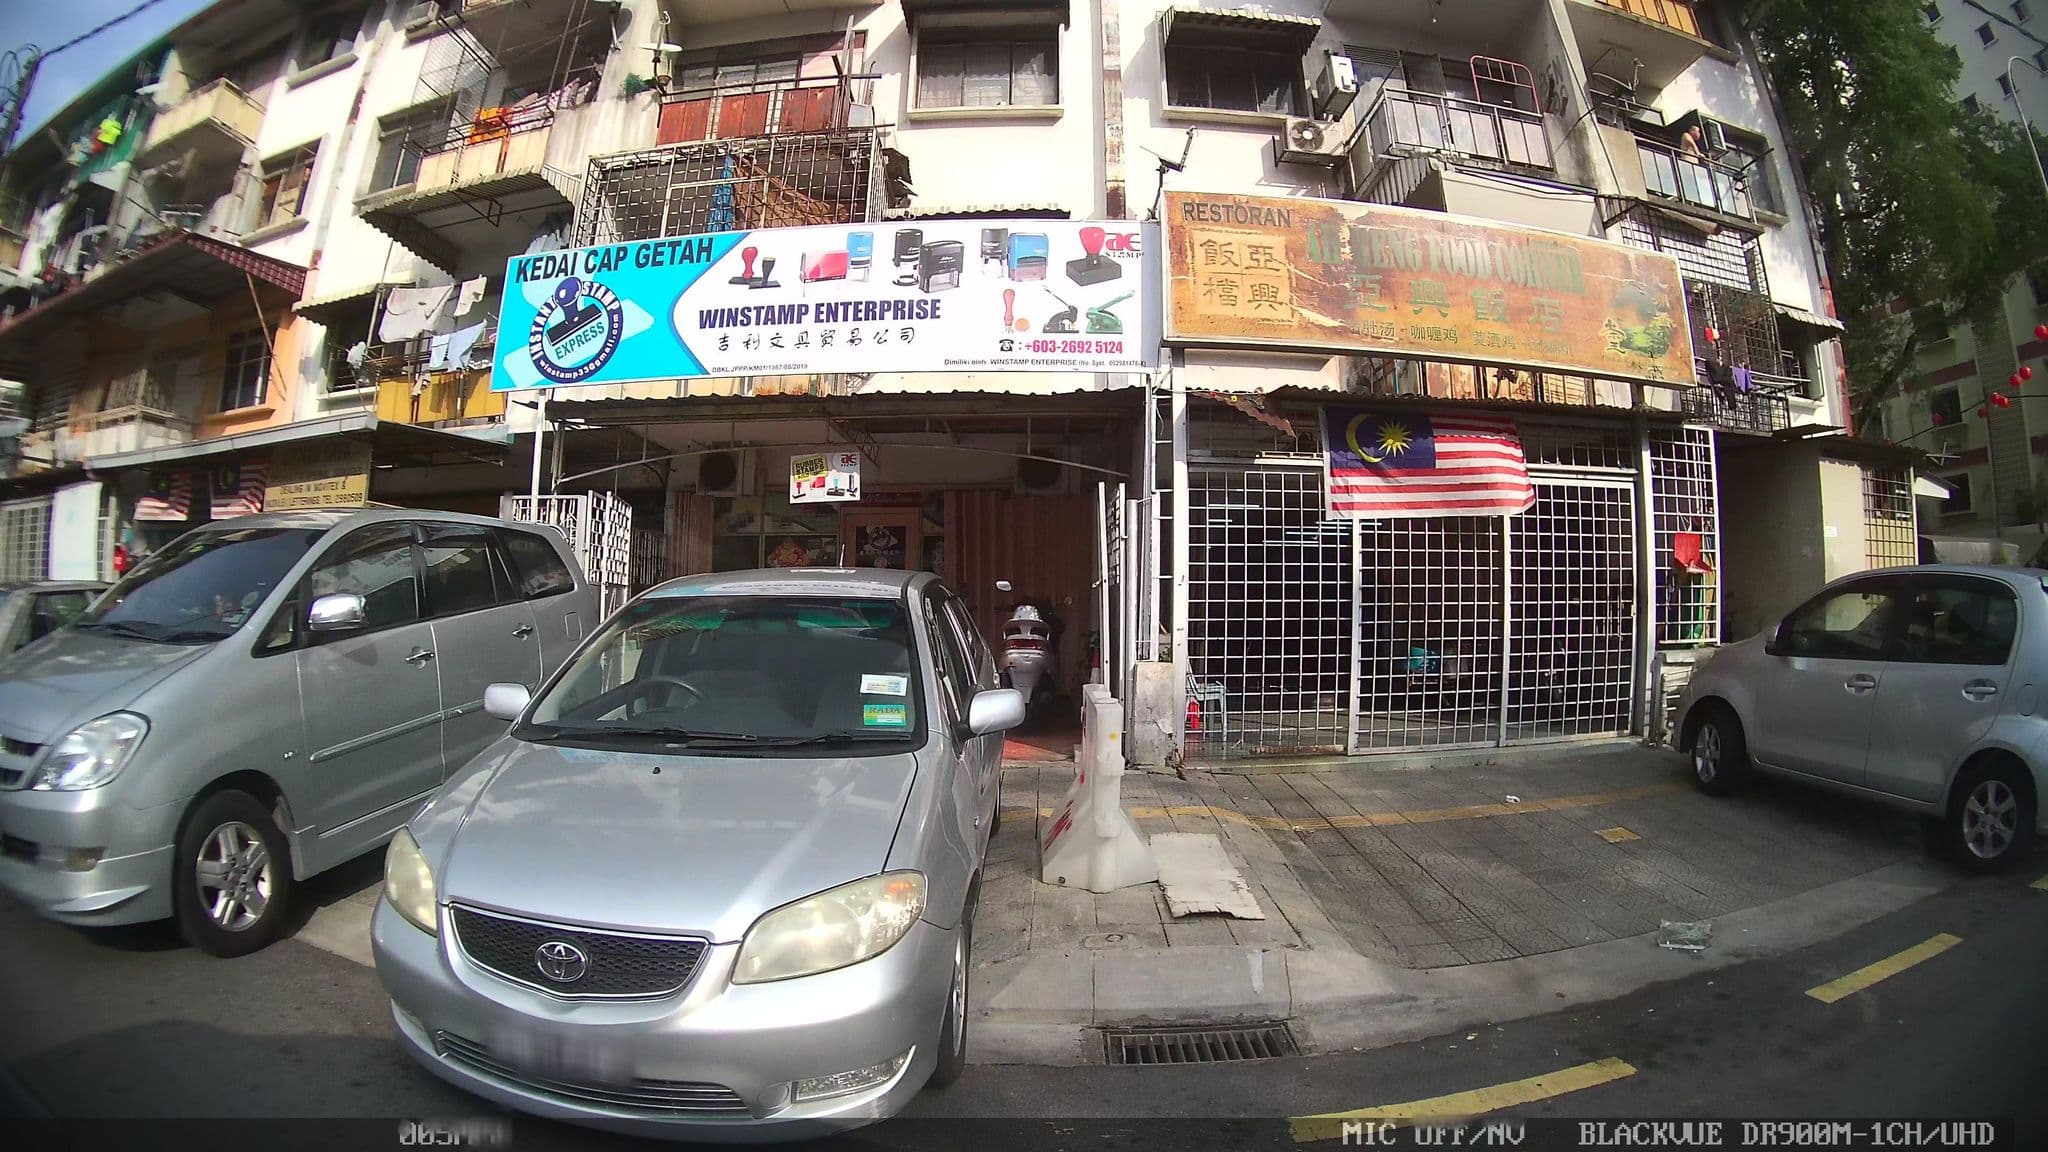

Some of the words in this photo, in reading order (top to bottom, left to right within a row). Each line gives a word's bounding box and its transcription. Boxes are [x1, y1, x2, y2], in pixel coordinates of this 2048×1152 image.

[1183, 202, 1292, 228] RESTORAN
[515, 252, 578, 283] KEDAI
[584, 246, 628, 274] CAP
[635, 237, 714, 269] GETAH
[581, 281, 620, 311] STAMP
[699, 303, 810, 330] WINSTAMP
[814, 298, 942, 324] ENTERPRISE
[554, 321, 605, 360] EXPRESS
[1024, 339, 1093, 354] +603-2692
[1095, 340, 1124, 354] 5124
[944, 358, 970, 366] Dimiliki
[990, 358, 1030, 366] WINSTAMP
[1031, 358, 1077, 366] ENTERPRISE
